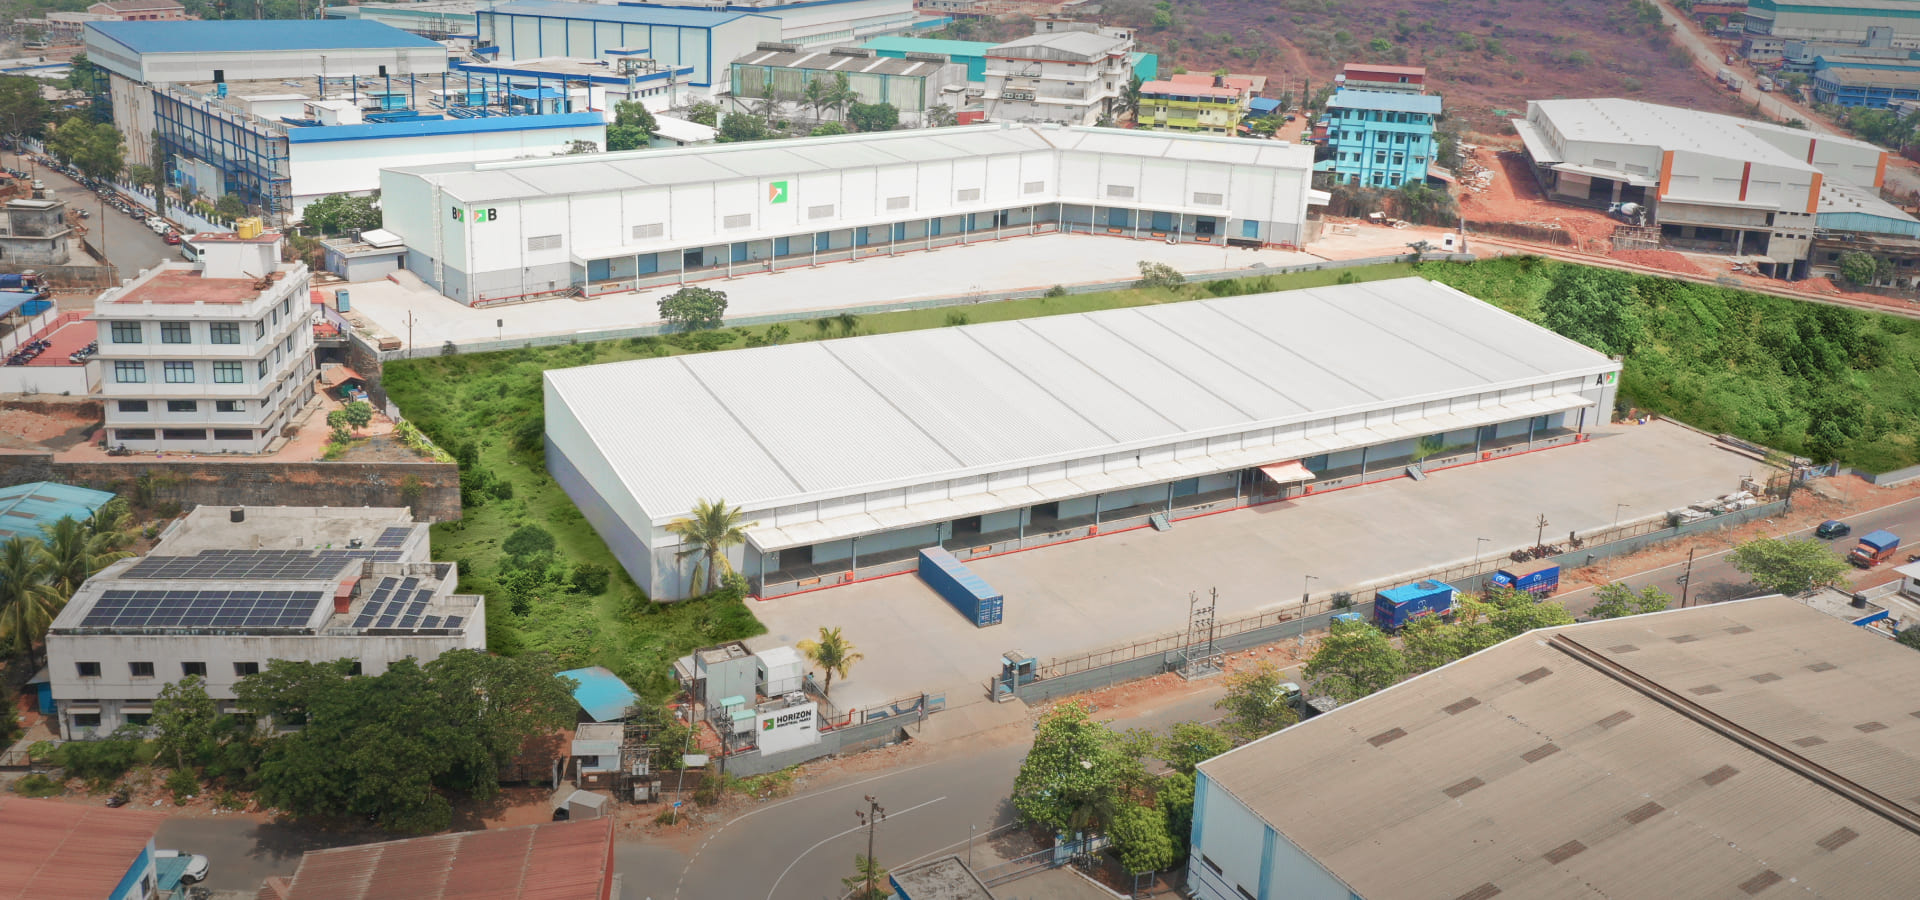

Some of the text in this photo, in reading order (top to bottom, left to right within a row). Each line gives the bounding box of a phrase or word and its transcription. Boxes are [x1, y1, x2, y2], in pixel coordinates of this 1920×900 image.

[452, 206, 457, 220] B
[488, 208, 497, 221] B
[1596, 373, 1602, 385] A
[777, 709, 811, 723] HORIZON
